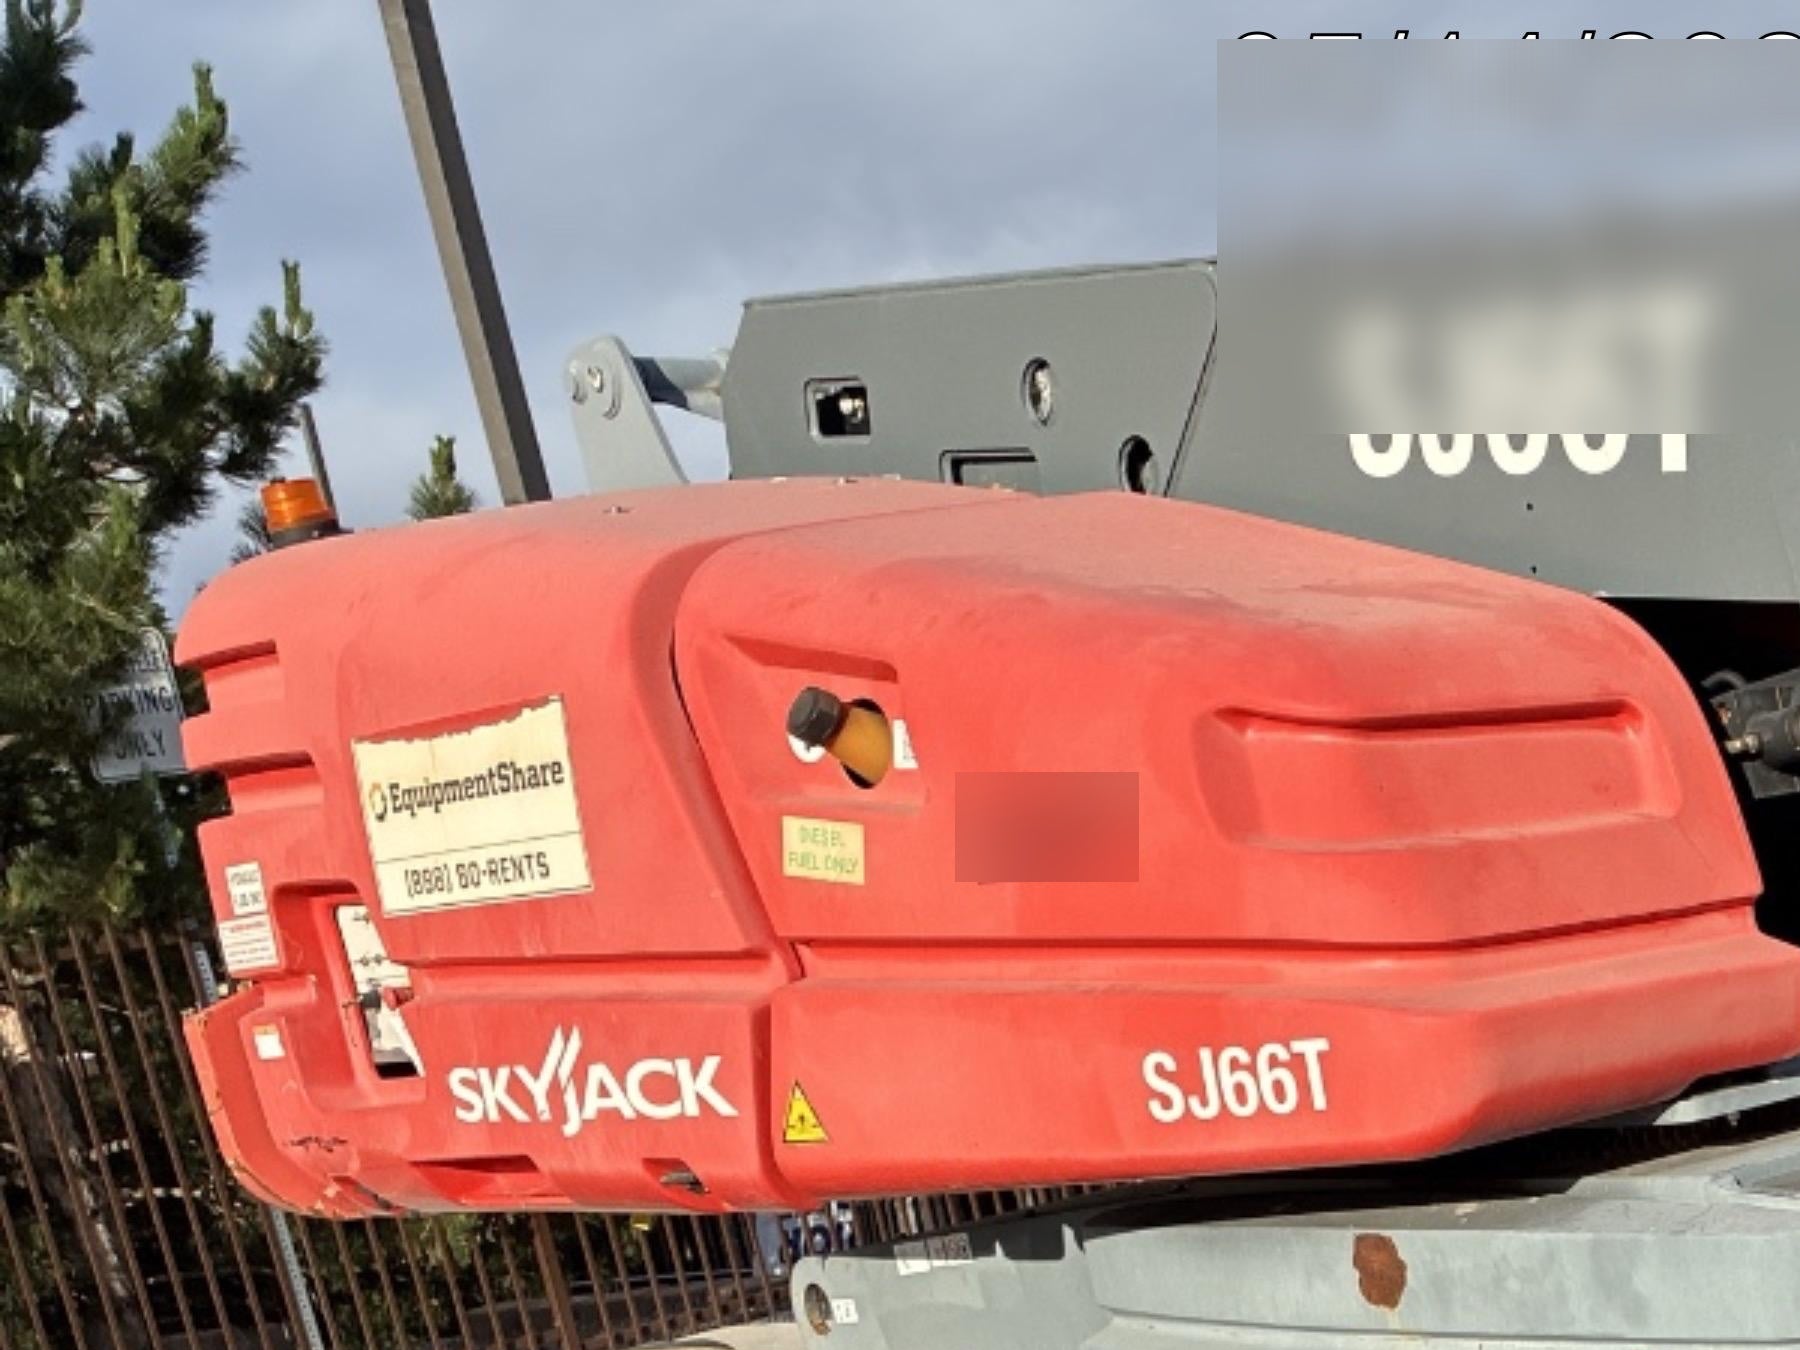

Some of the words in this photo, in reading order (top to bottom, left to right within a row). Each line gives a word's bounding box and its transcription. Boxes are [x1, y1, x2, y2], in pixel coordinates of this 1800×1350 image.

[389, 760, 565, 818] EquipmentShare
[825, 853, 858, 874] ONLY
[448, 1024, 739, 1138] SKYJACK
[1142, 1037, 1330, 1123] SJ66T
